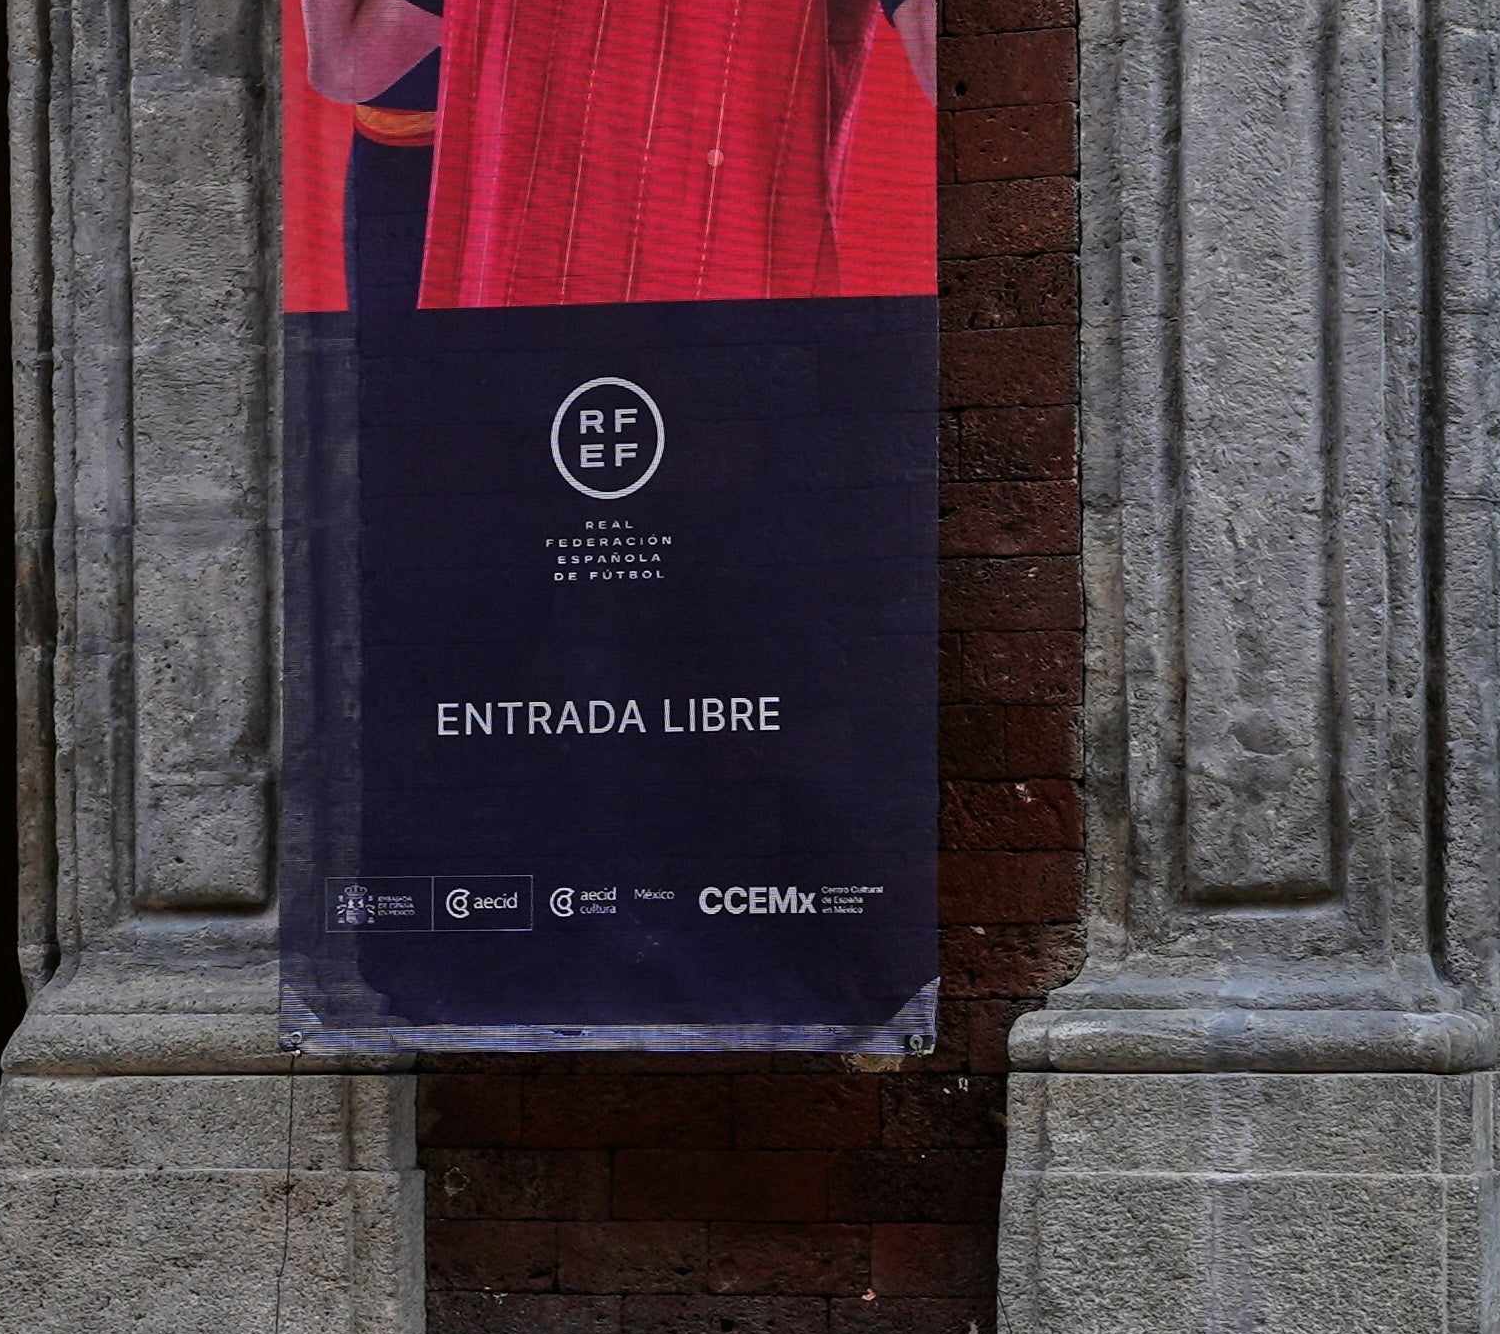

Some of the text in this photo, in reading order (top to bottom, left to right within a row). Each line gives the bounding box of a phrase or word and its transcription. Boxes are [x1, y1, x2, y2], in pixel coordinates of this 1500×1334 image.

[585, 520, 634, 529] REAL
[545, 534, 672, 548] FEDERACIÓN
[557, 552, 662, 564] ESPAÑOLA
[553, 569, 665, 581] DE FÚTBOL
[437, 695, 782, 737] ENTRADA LIBRE
[579, 886, 618, 901] aecid
[633, 887, 676, 901] México
[820, 885, 885, 895] Centro Cultural
[472, 890, 519, 910] aecid
[698, 885, 818, 916] CCEMx
[820, 895, 833, 905] de
[579, 901, 618, 915] cultura
